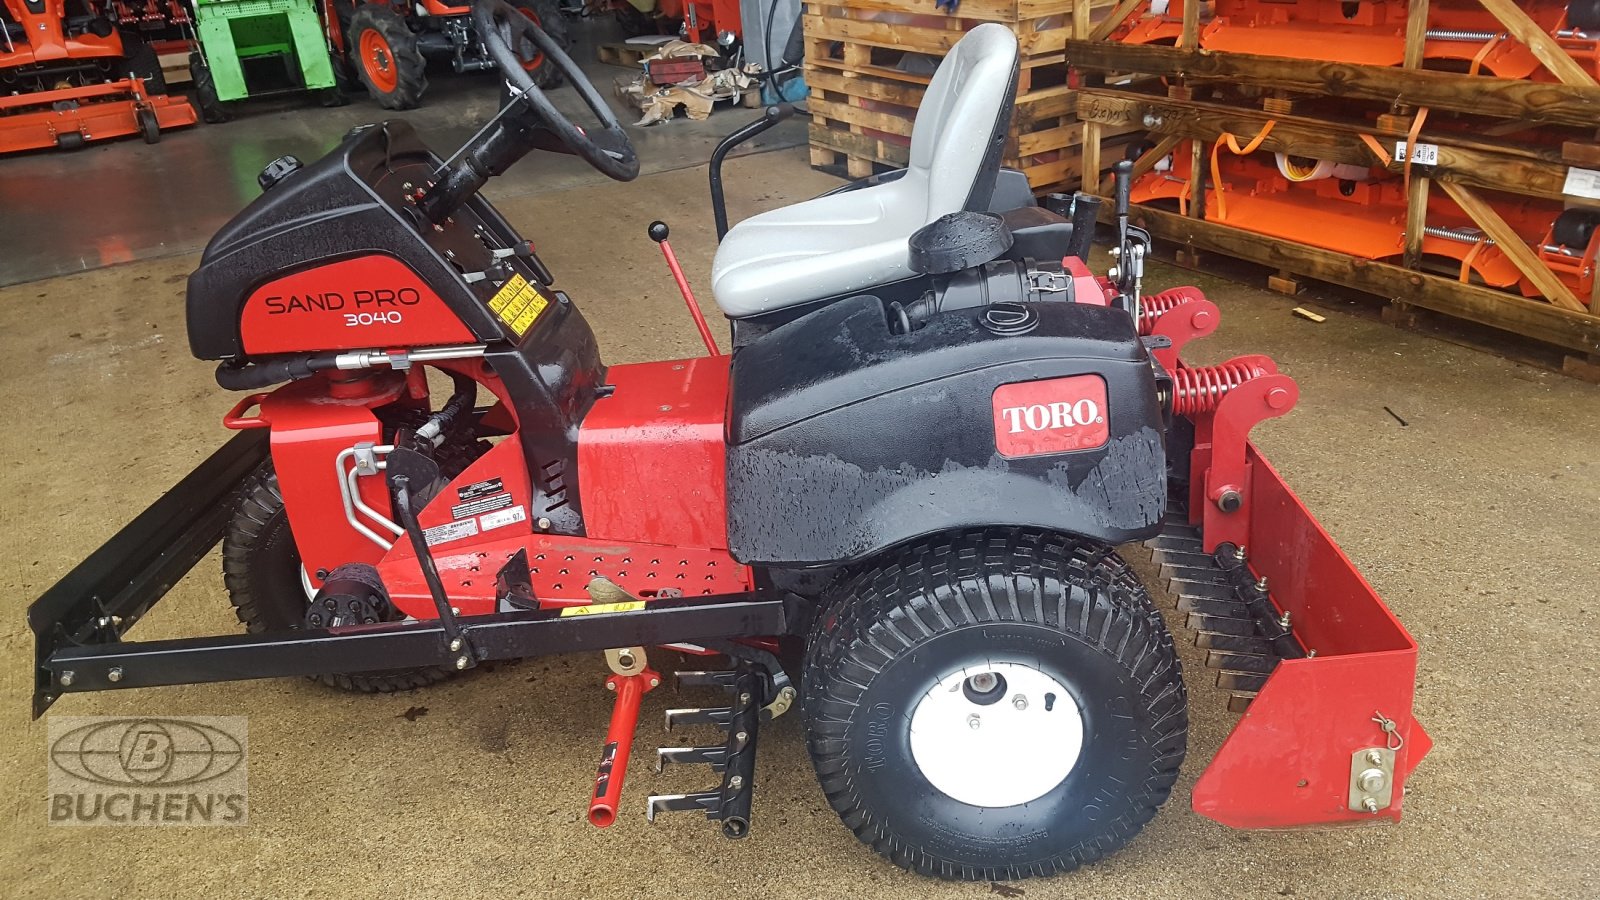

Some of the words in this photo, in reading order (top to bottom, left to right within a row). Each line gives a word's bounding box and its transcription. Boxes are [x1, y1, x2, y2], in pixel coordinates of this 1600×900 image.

[265, 292, 345, 315] SAND
[353, 287, 420, 309] PRO
[343, 311, 402, 327] 3040
[1003, 398, 1099, 433] TORO
